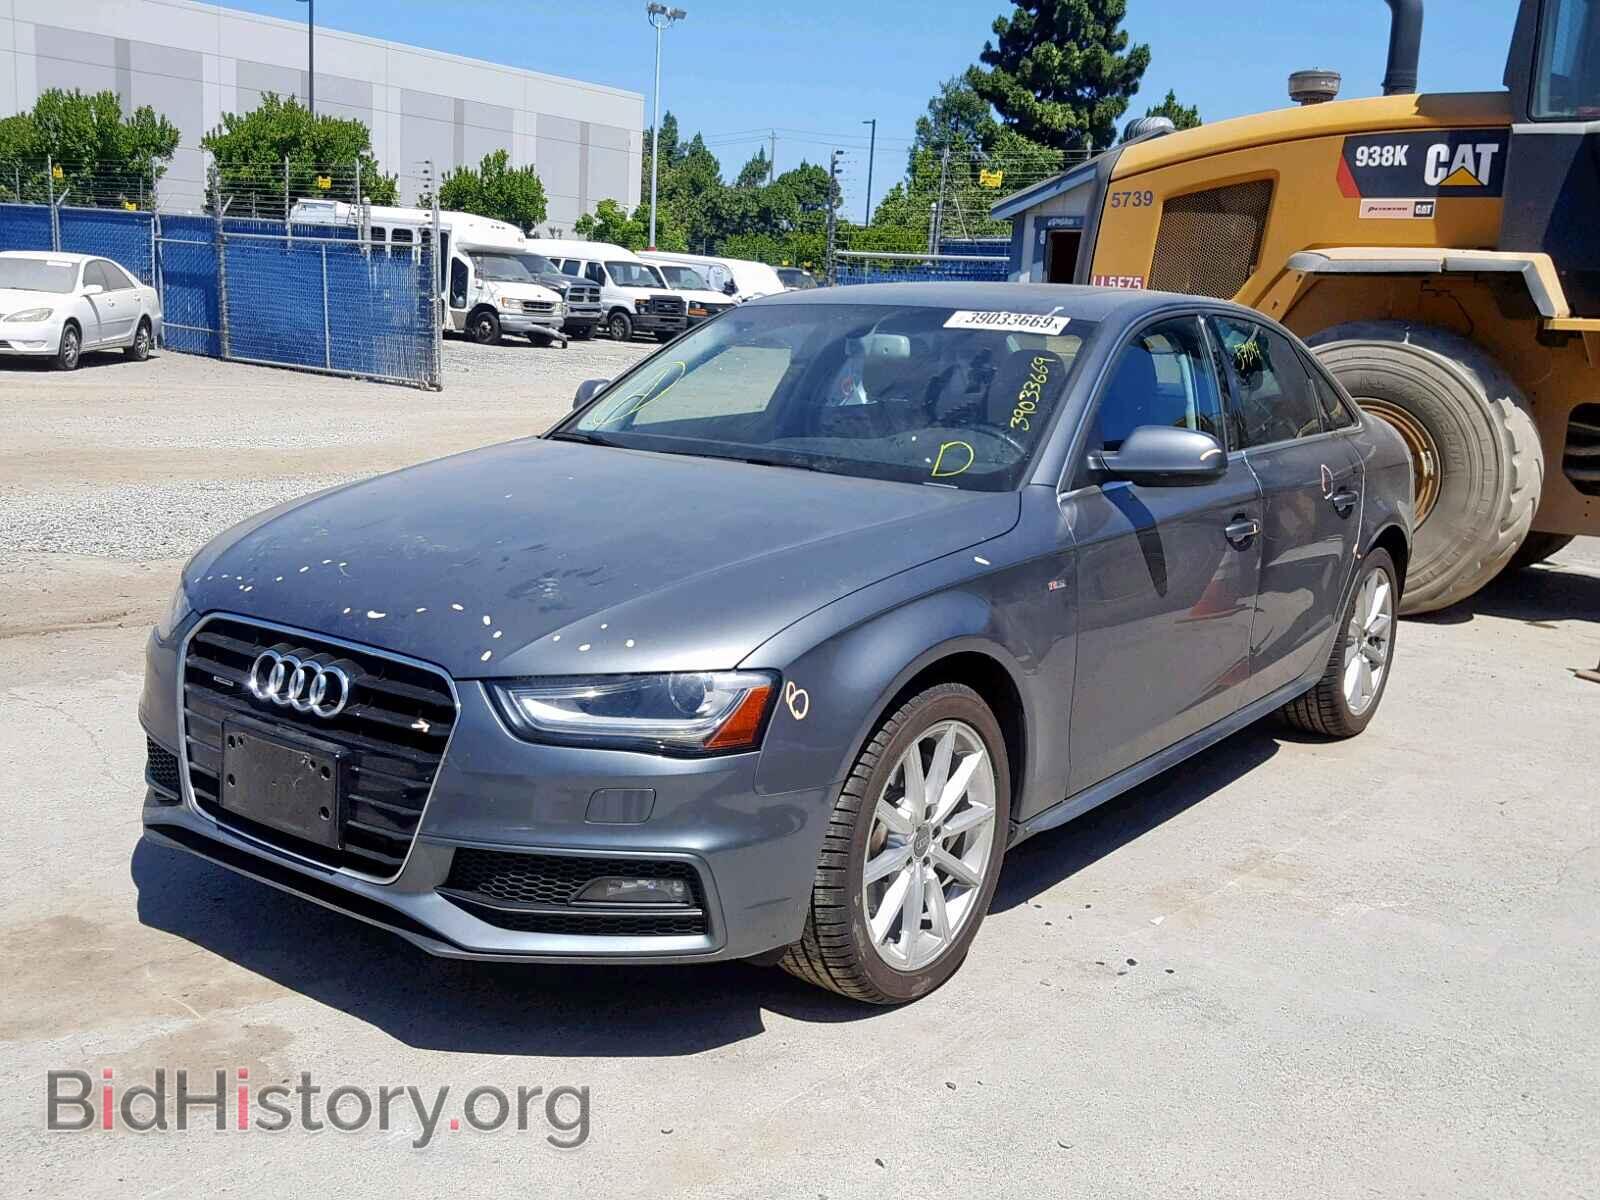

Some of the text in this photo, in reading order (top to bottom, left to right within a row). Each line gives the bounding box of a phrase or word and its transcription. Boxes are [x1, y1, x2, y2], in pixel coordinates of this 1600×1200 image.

[1355, 144, 1409, 167] 938K
[1424, 143, 1499, 186] CAT
[1111, 190, 1154, 208] 5739
[1415, 204, 1433, 215] CAT
[964, 311, 1055, 329] 39033669
[1010, 356, 1056, 431] 39033669
[931, 440, 974, 476] D
